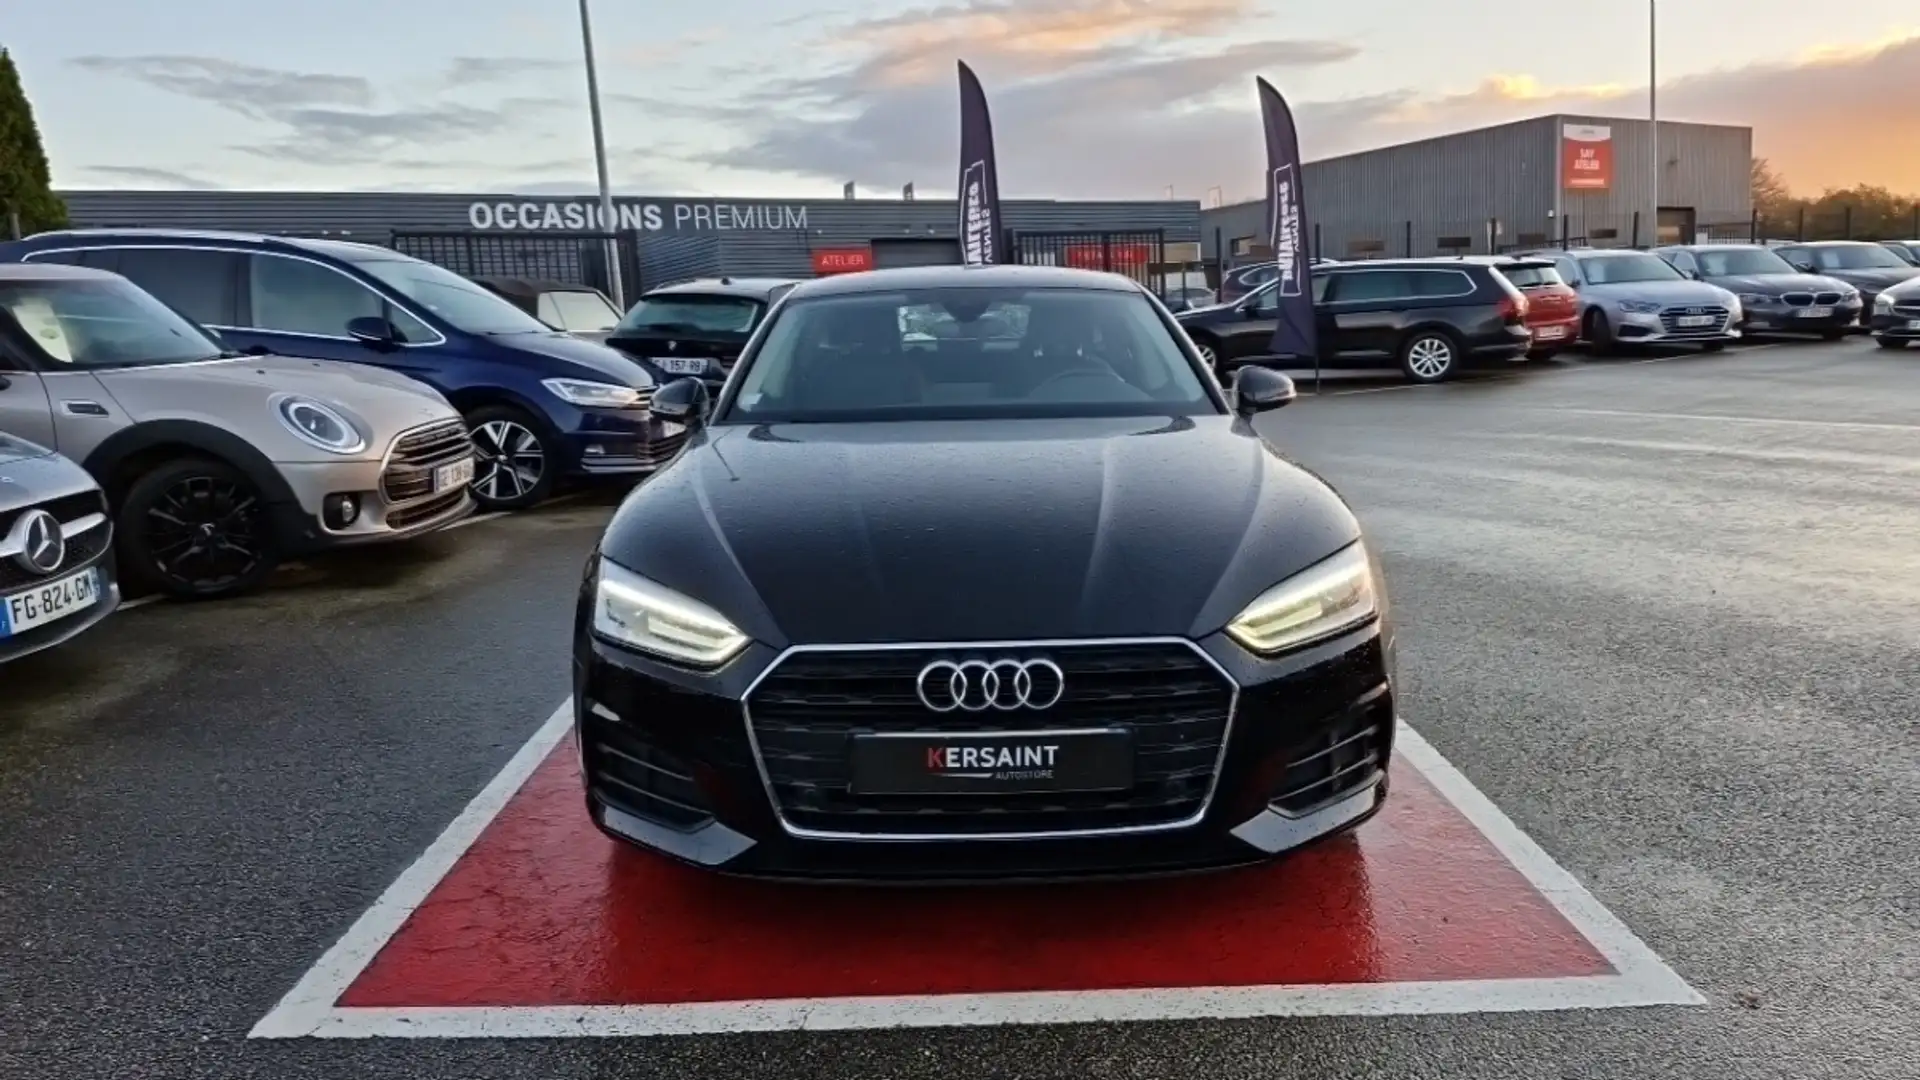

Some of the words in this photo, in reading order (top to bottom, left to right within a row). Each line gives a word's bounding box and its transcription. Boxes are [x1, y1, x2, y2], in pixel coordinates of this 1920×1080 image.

[468, 203, 662, 229] OCCASIONS
[674, 204, 808, 230] PREMIUM
[821, 254, 864, 266] ATELIER
[11, 573, 93, 624] FG-824-GM
[927, 745, 1059, 768] KERSAINT
[995, 770, 1054, 780] AUTOSTORE
